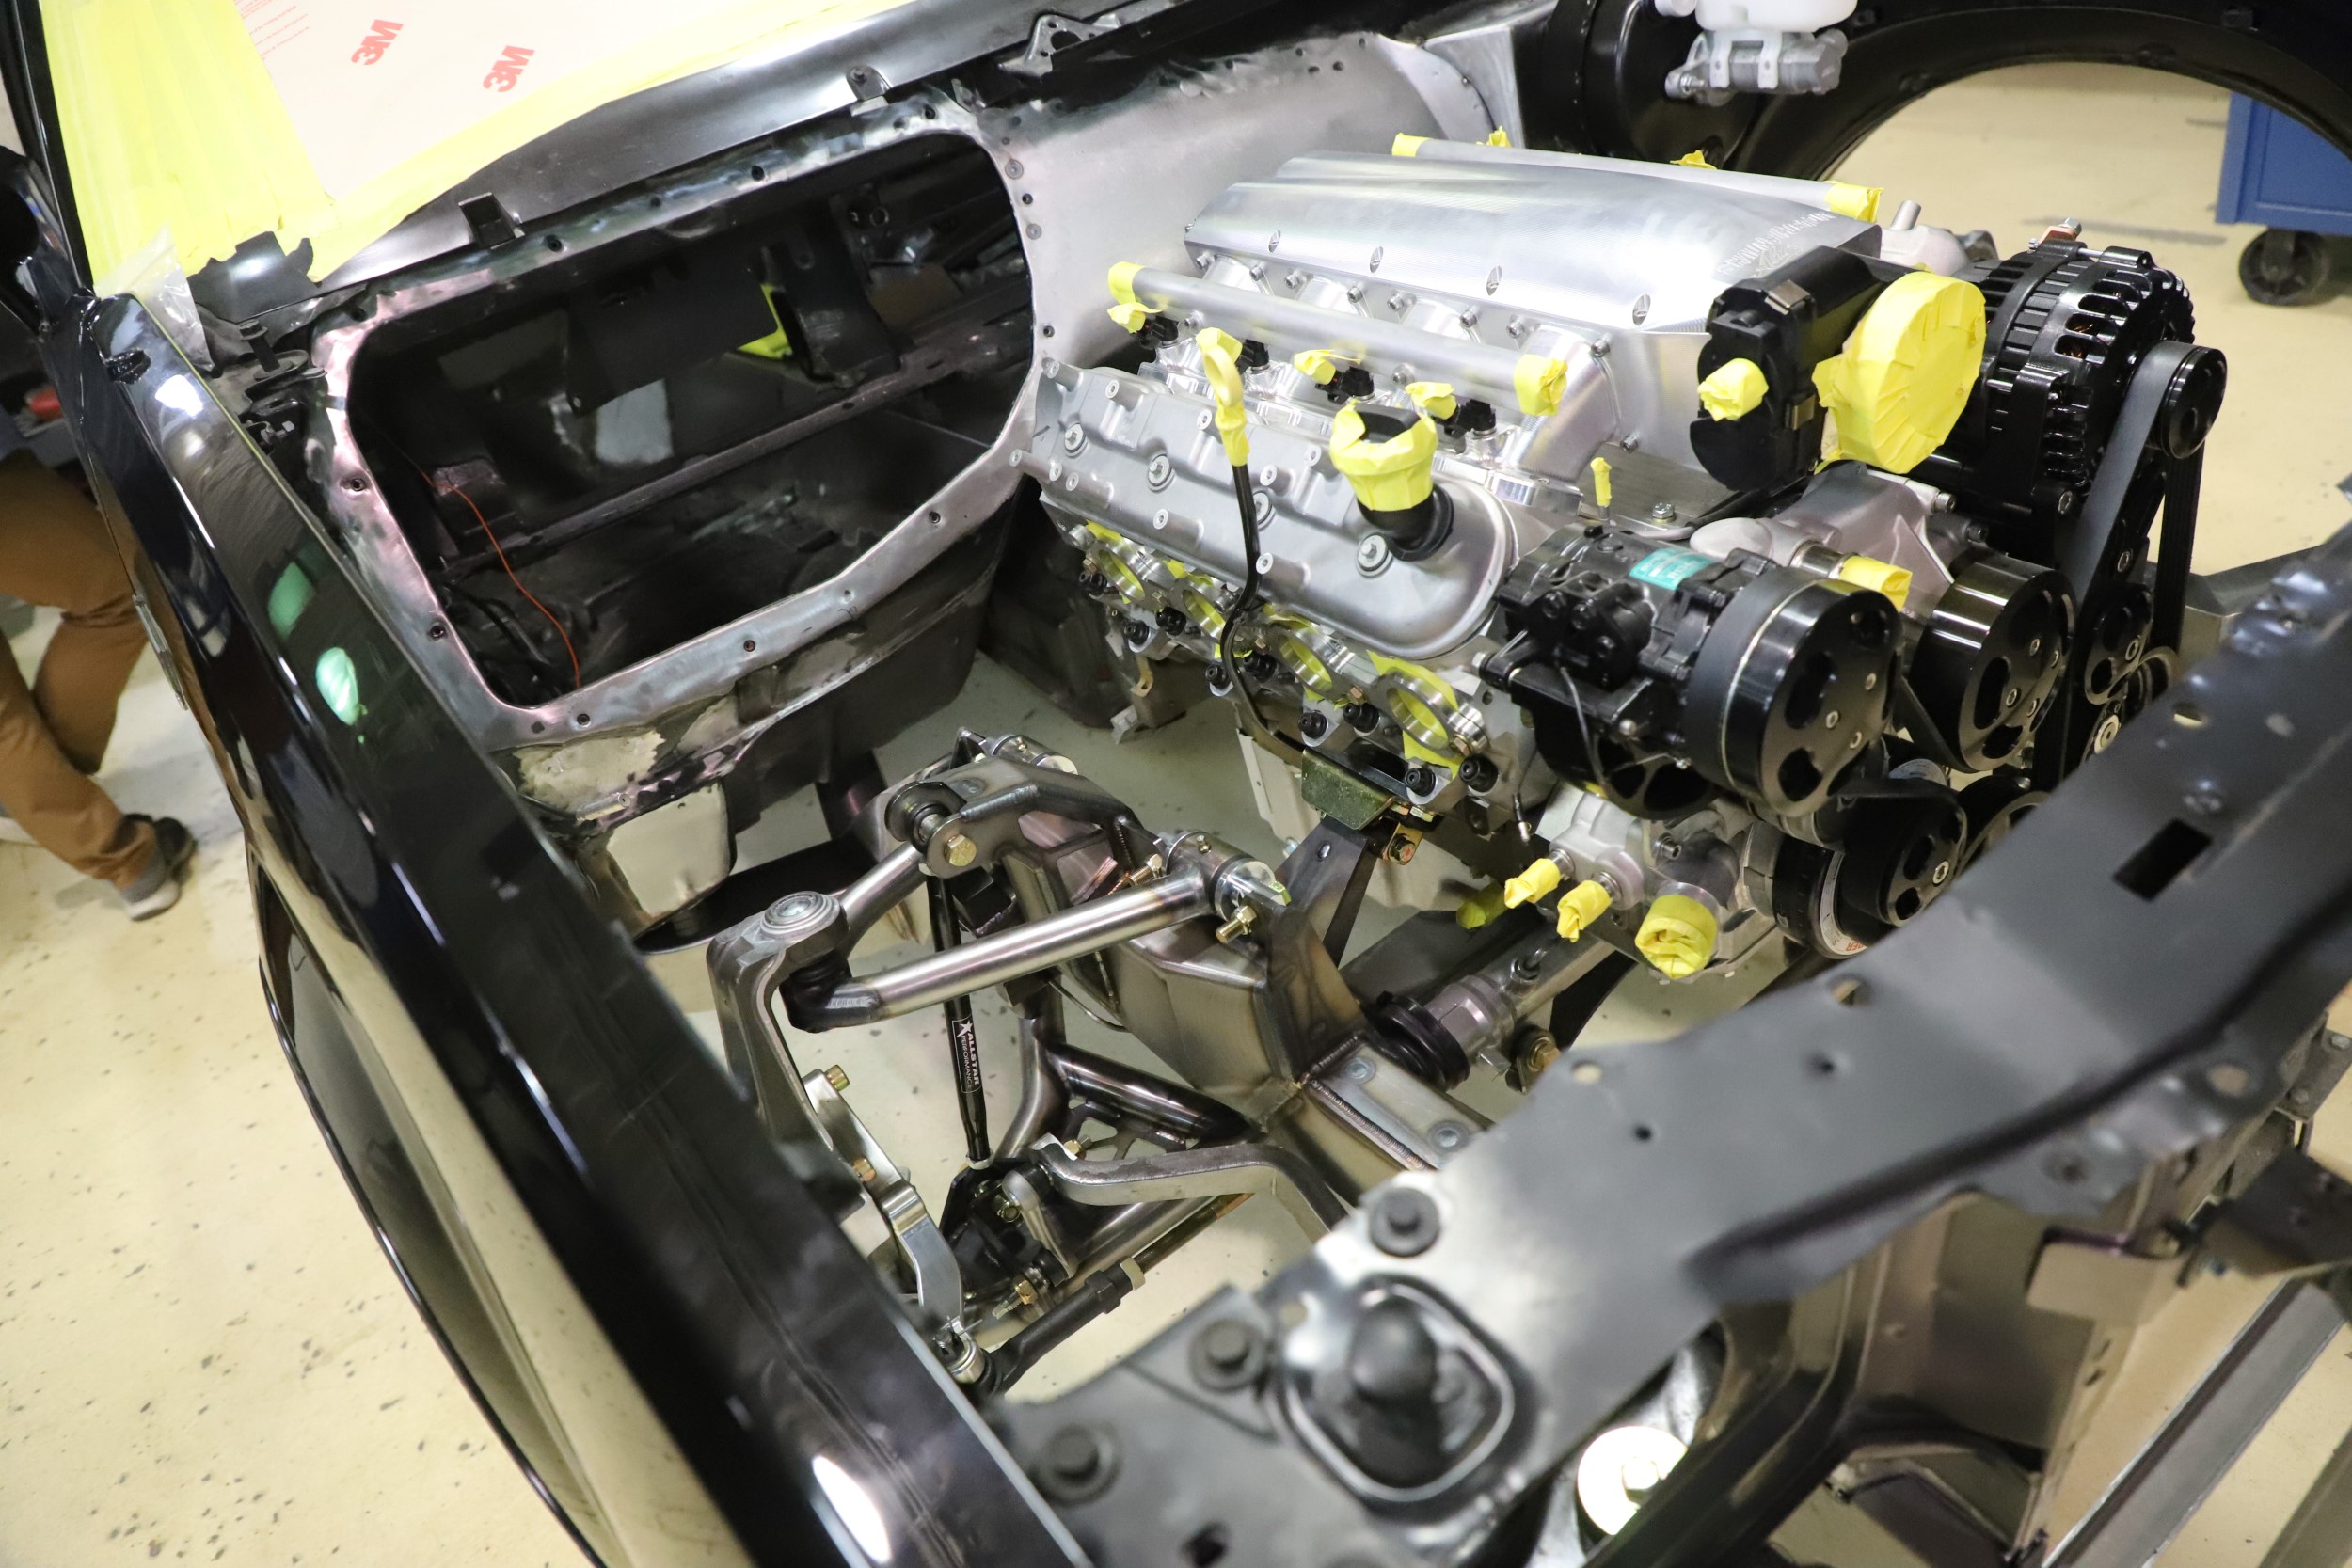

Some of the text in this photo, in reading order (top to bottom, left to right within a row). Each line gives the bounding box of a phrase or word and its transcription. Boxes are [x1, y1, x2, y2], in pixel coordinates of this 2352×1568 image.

[351, 20, 403, 65] 3M
[484, 46, 534, 92] 3M
[961, 1035, 973, 1089] PERFORMANCE
[967, 1032, 980, 1085] ALLSTAR
